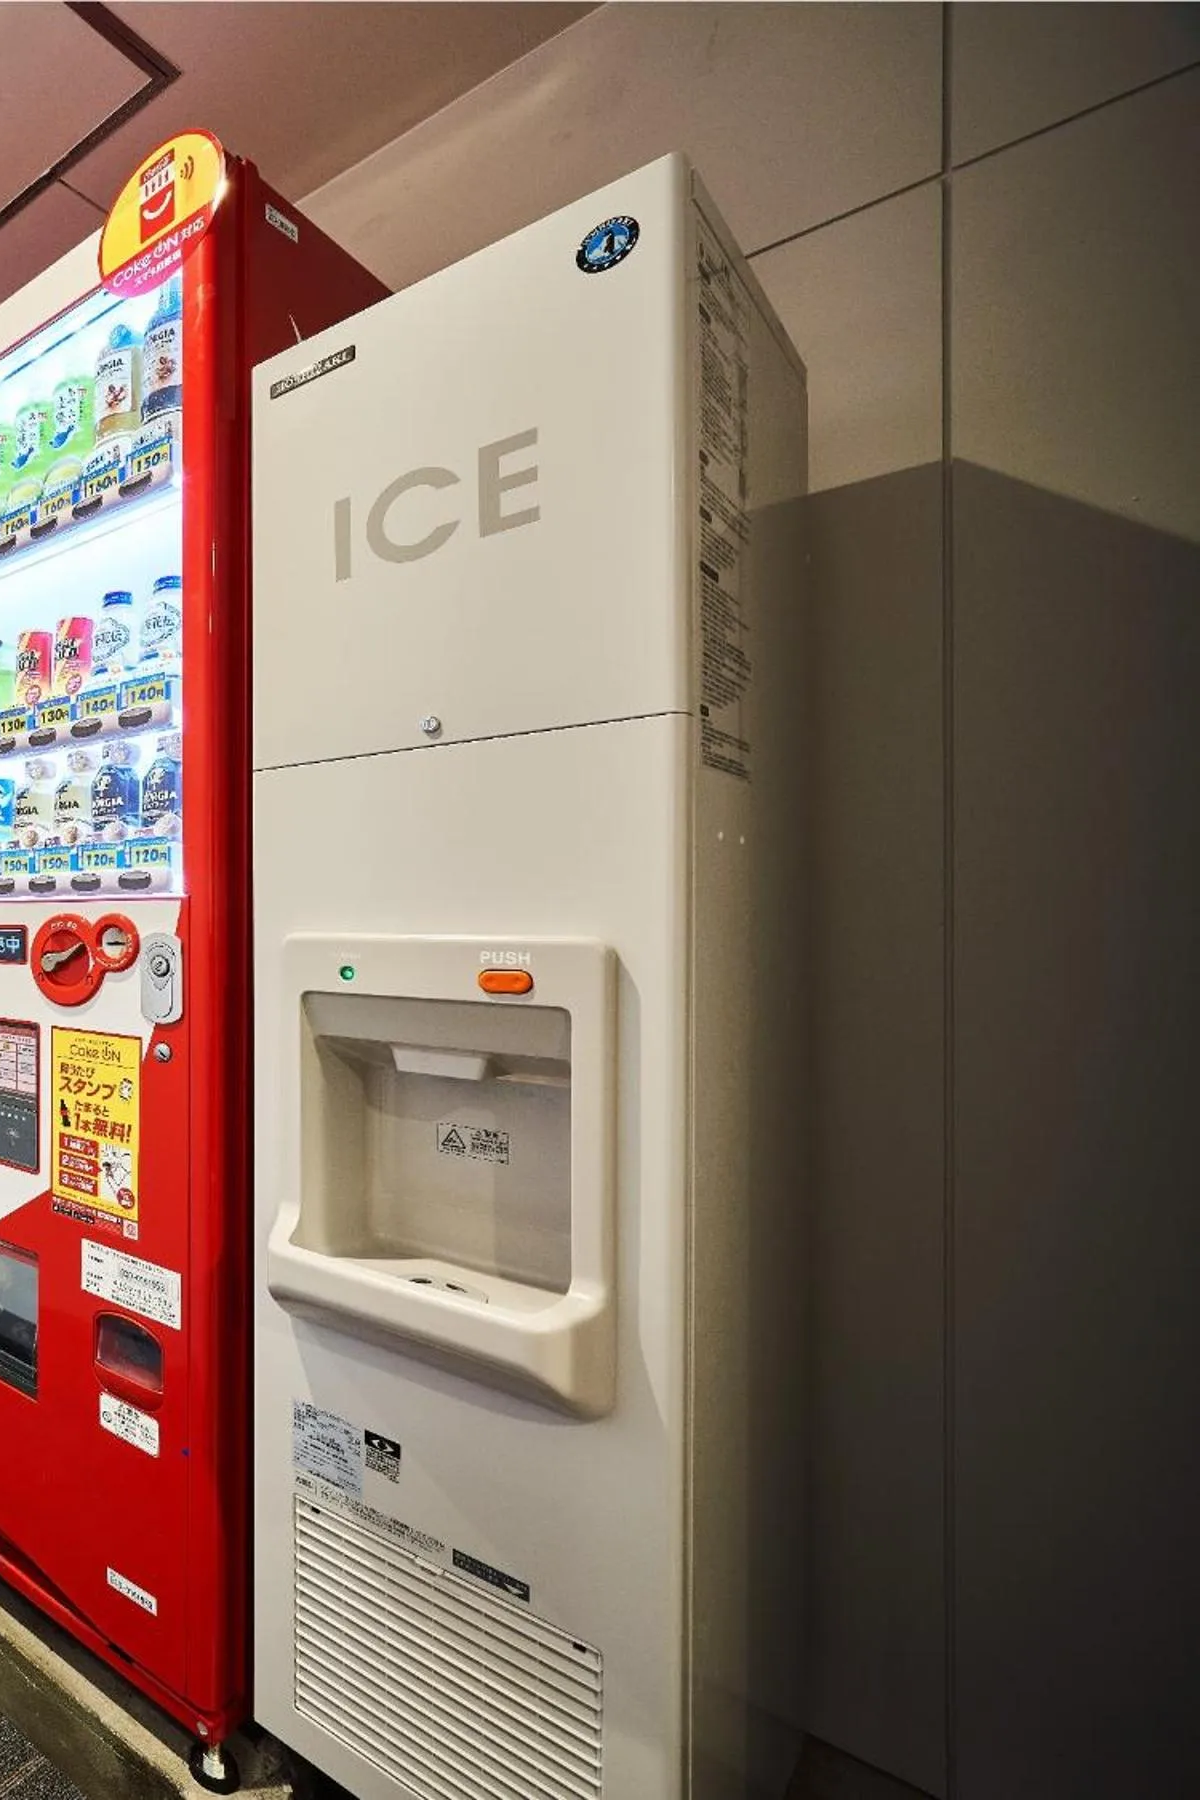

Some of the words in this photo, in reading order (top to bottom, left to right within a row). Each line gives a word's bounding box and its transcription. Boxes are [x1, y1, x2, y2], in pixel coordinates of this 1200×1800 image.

[334, 426, 542, 583] ICE
[479, 950, 532, 967] PUSH
[69, 1044, 101, 1060] Coke
[58, 1076, 117, 1101] スタンプ
[74, 1099, 110, 1118] たまると
